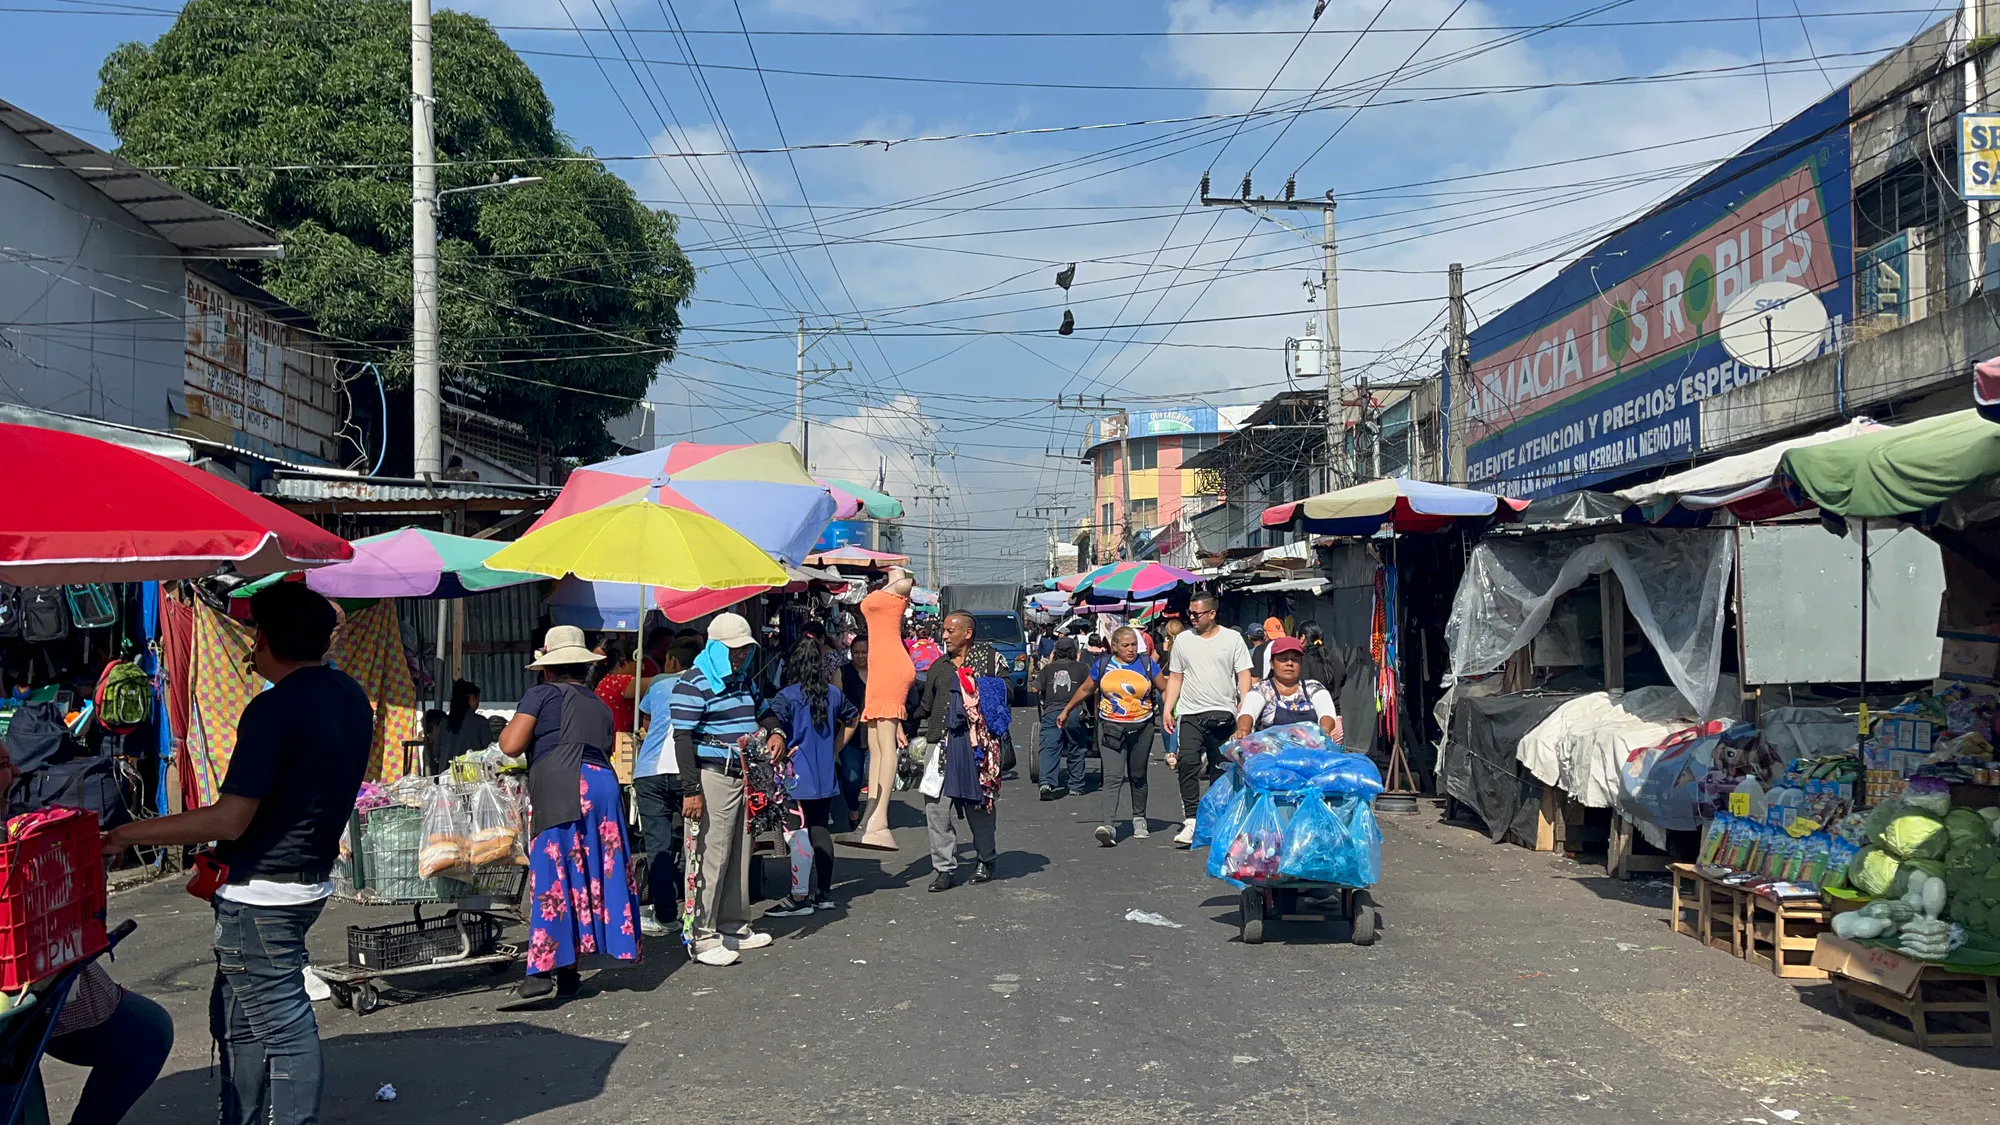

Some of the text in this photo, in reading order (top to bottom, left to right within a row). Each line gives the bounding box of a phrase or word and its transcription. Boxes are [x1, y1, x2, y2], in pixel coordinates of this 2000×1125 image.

[1465, 328, 1584, 433] ARMACIA
[1663, 198, 1813, 339] ROBLES
[1754, 298, 1789, 312] SKY
[1467, 447, 1516, 484] CELENTE
[1518, 420, 1585, 465] ATENCION
[1588, 413, 1600, 440] Y
[1602, 382, 1676, 435] PRECIOS
[1535, 468, 1542, 490] A
[1573, 452, 1588, 479] SIN
[1589, 441, 1624, 473] CERRAR
[1625, 435, 1638, 463] AL
[1639, 422, 1671, 458] MEDIO
[1673, 416, 1692, 447] DIA
